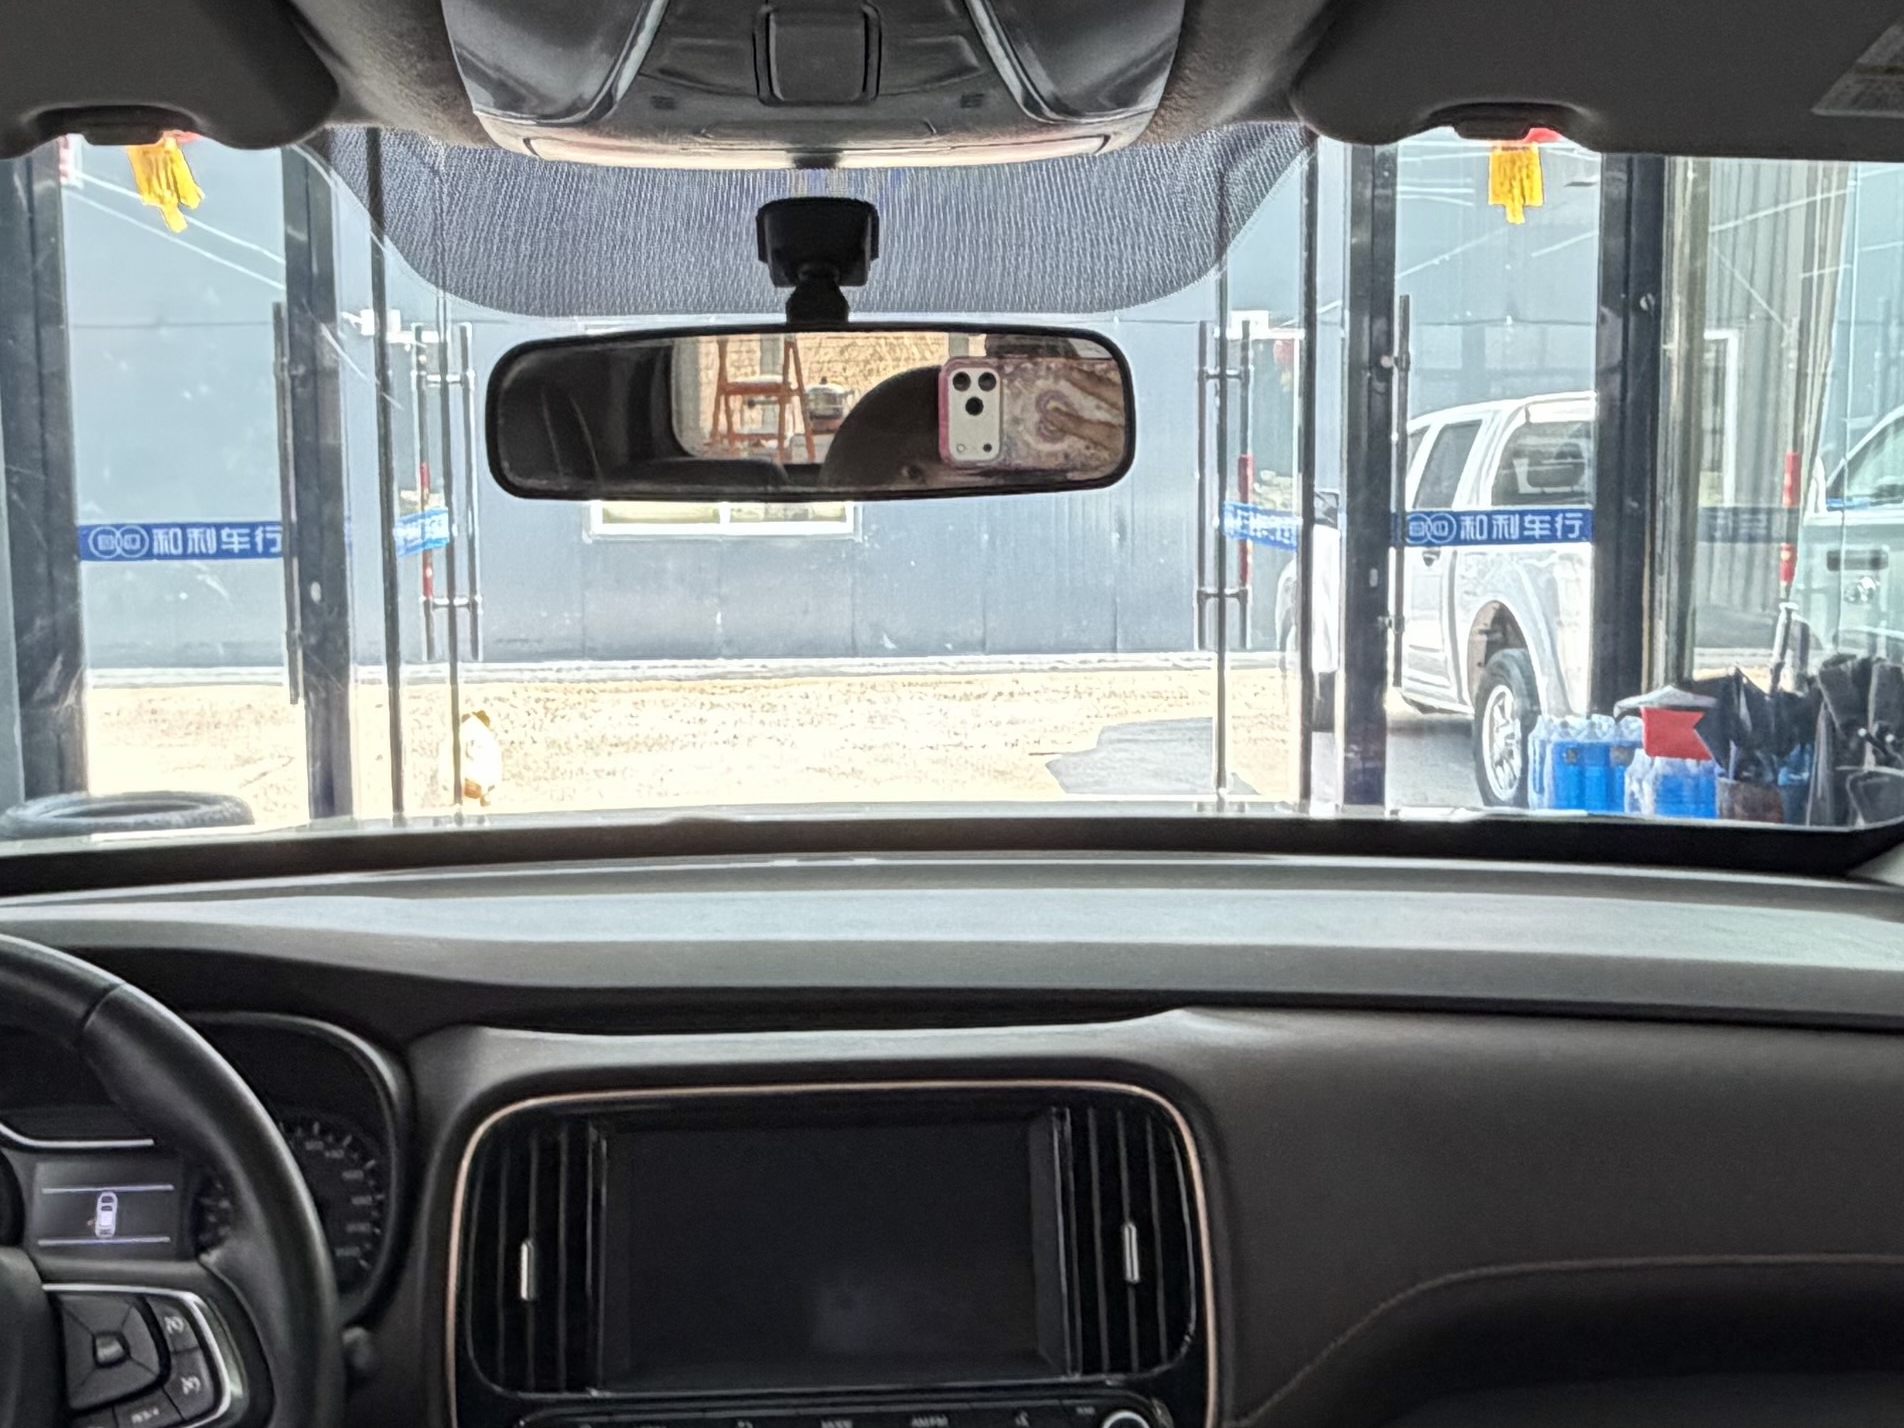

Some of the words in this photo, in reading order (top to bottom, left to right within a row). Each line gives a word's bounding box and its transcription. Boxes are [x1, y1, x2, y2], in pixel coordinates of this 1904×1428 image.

[151, 524, 283, 556] 和利车行
[1459, 512, 1584, 541] 和利车行
